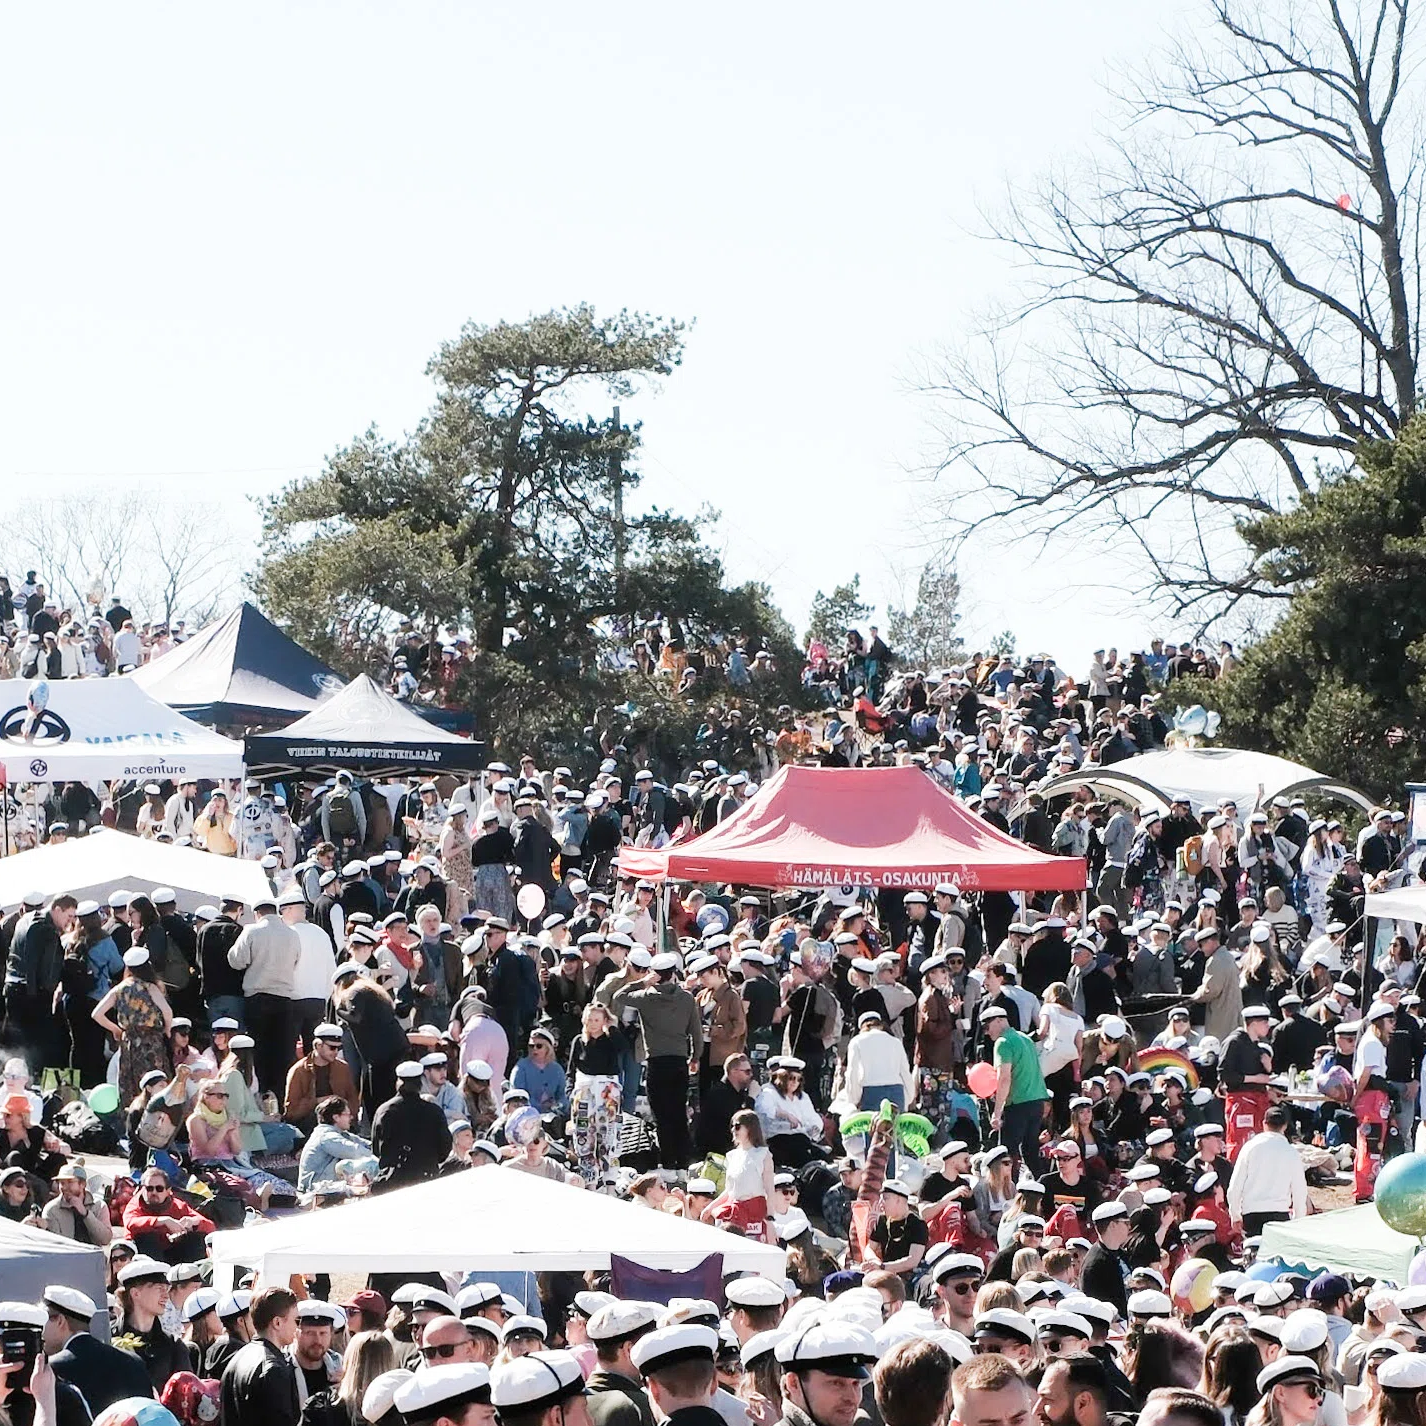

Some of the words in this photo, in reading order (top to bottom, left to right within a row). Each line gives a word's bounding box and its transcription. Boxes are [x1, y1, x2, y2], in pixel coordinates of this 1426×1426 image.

[286, 746, 326, 758] VIIKIN
[124, 764, 186, 775] accenture
[793, 867, 962, 886] HÄMÄLÄIS-OSAKUNTA
